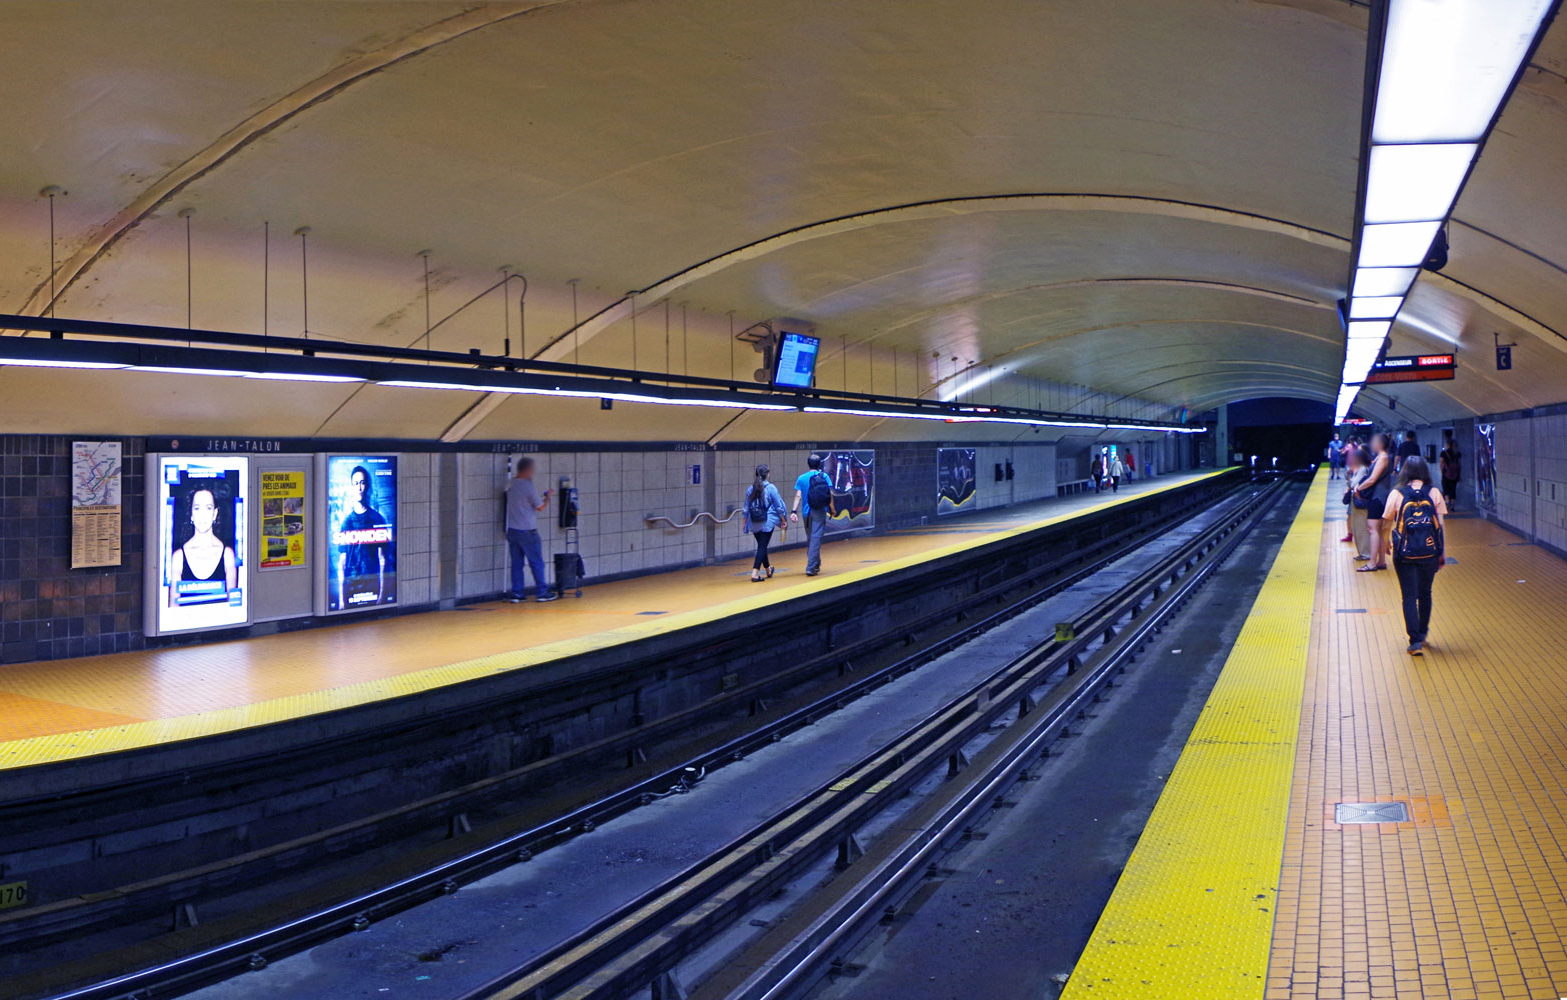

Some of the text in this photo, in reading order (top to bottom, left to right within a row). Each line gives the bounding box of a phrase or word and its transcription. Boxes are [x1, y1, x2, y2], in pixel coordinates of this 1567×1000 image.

[1421, 357, 1449, 365] SORTIE
[207, 440, 281, 452] JEAN-TALON
[263, 473, 275, 481] VENEZ
[280, 481, 297, 489] ANIMAUX
[332, 527, 393, 546] SNOWDEN
